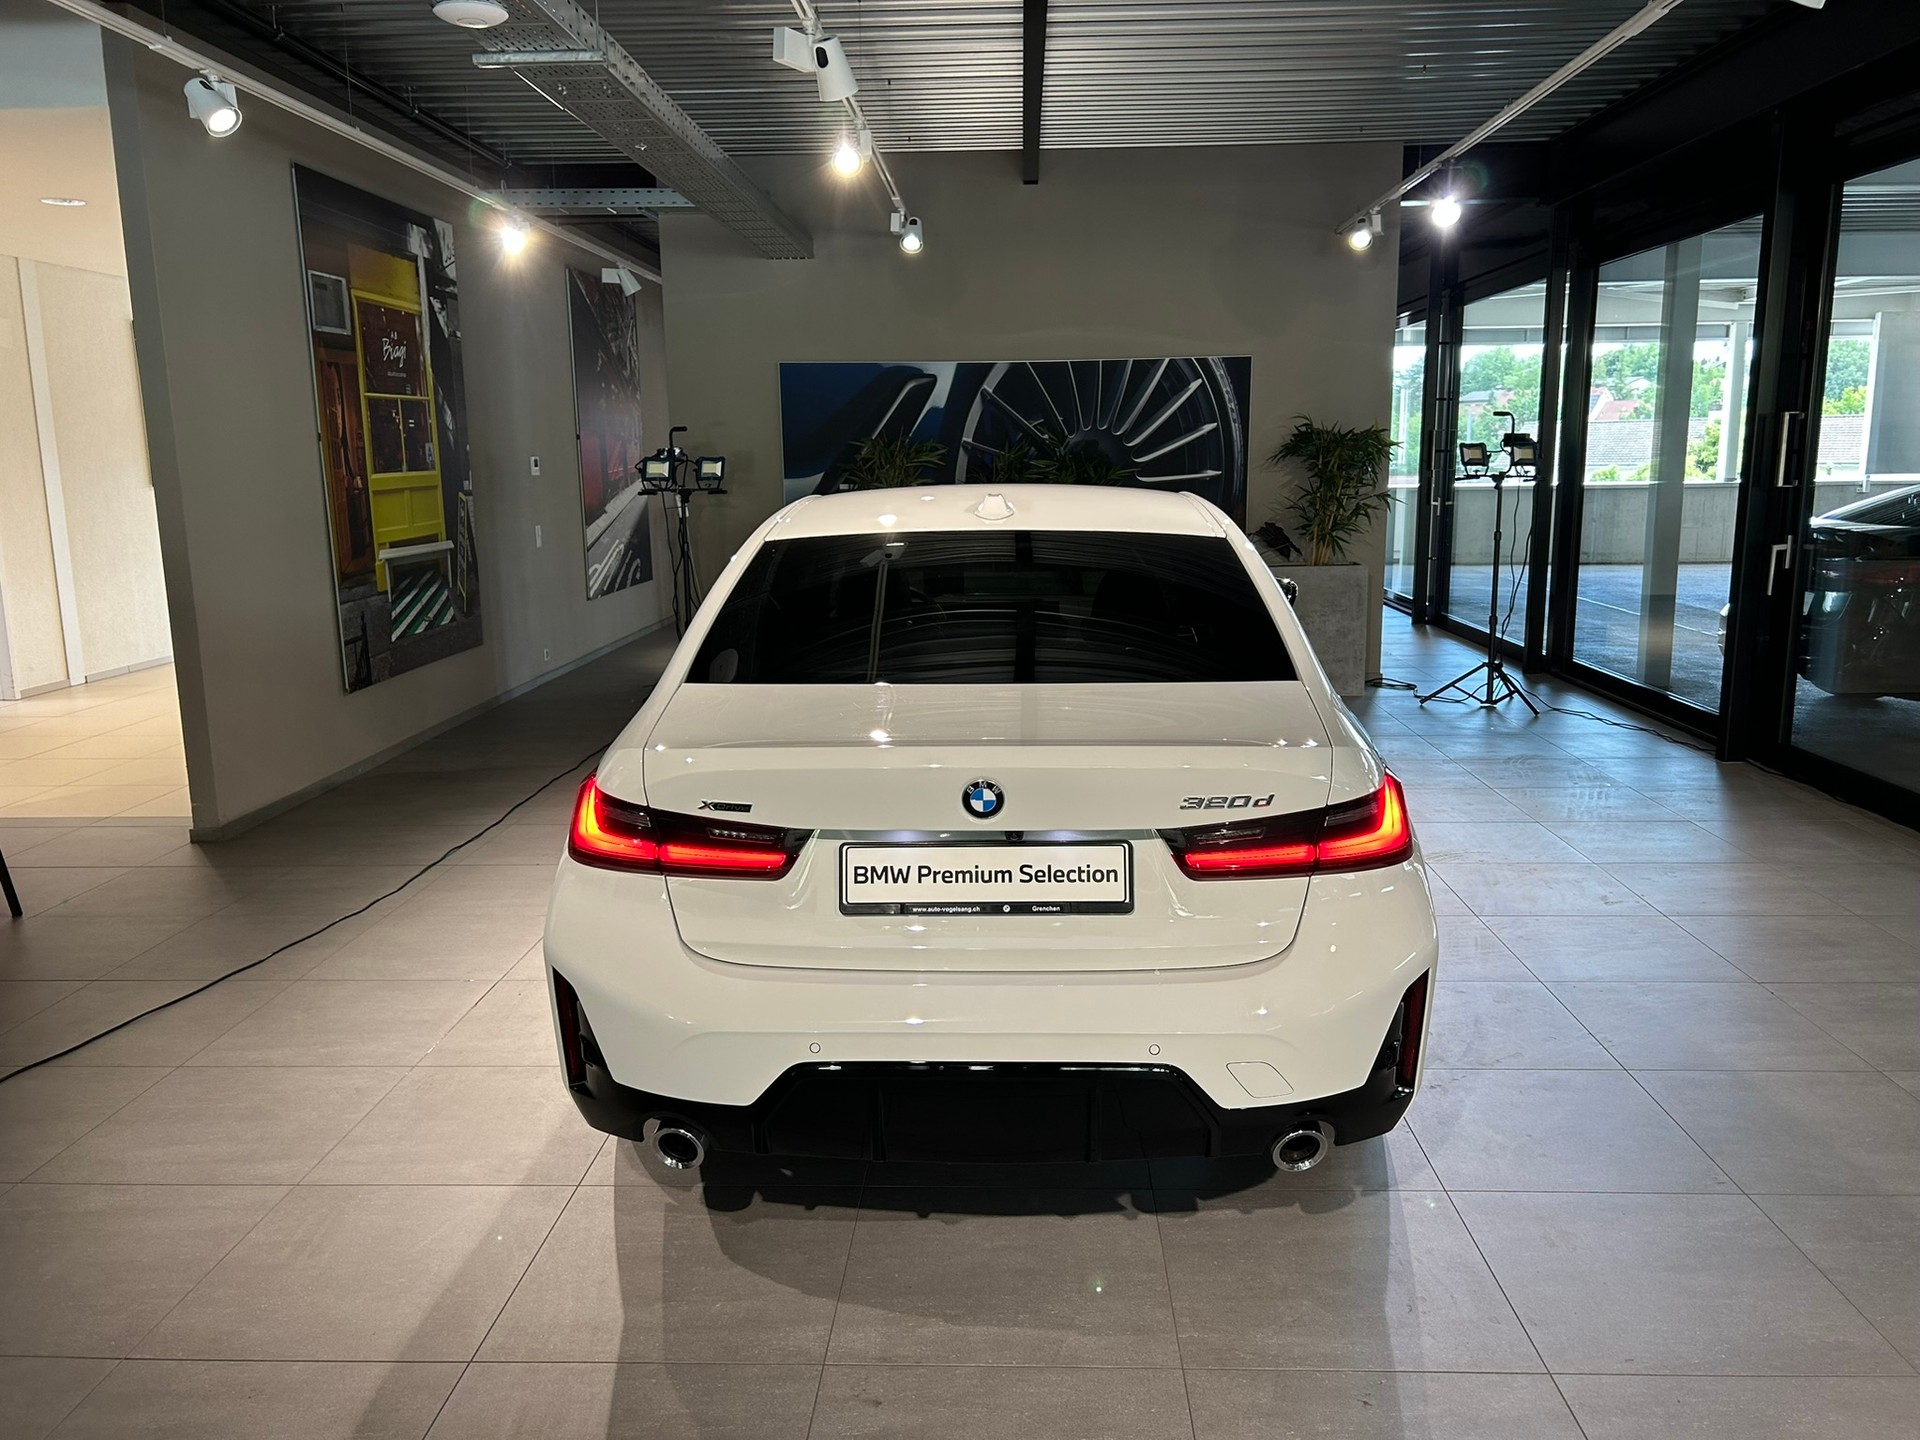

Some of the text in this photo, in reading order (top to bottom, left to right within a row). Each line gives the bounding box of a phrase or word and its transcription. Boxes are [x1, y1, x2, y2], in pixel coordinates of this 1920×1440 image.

[382, 337, 407, 368] Biagi
[1179, 794, 1275, 810] 320d
[853, 863, 1119, 885] BMW Premium Selection
[912, 905, 981, 914] www.auto-vogelsang.ch
[1031, 905, 1061, 913] Grenchen
